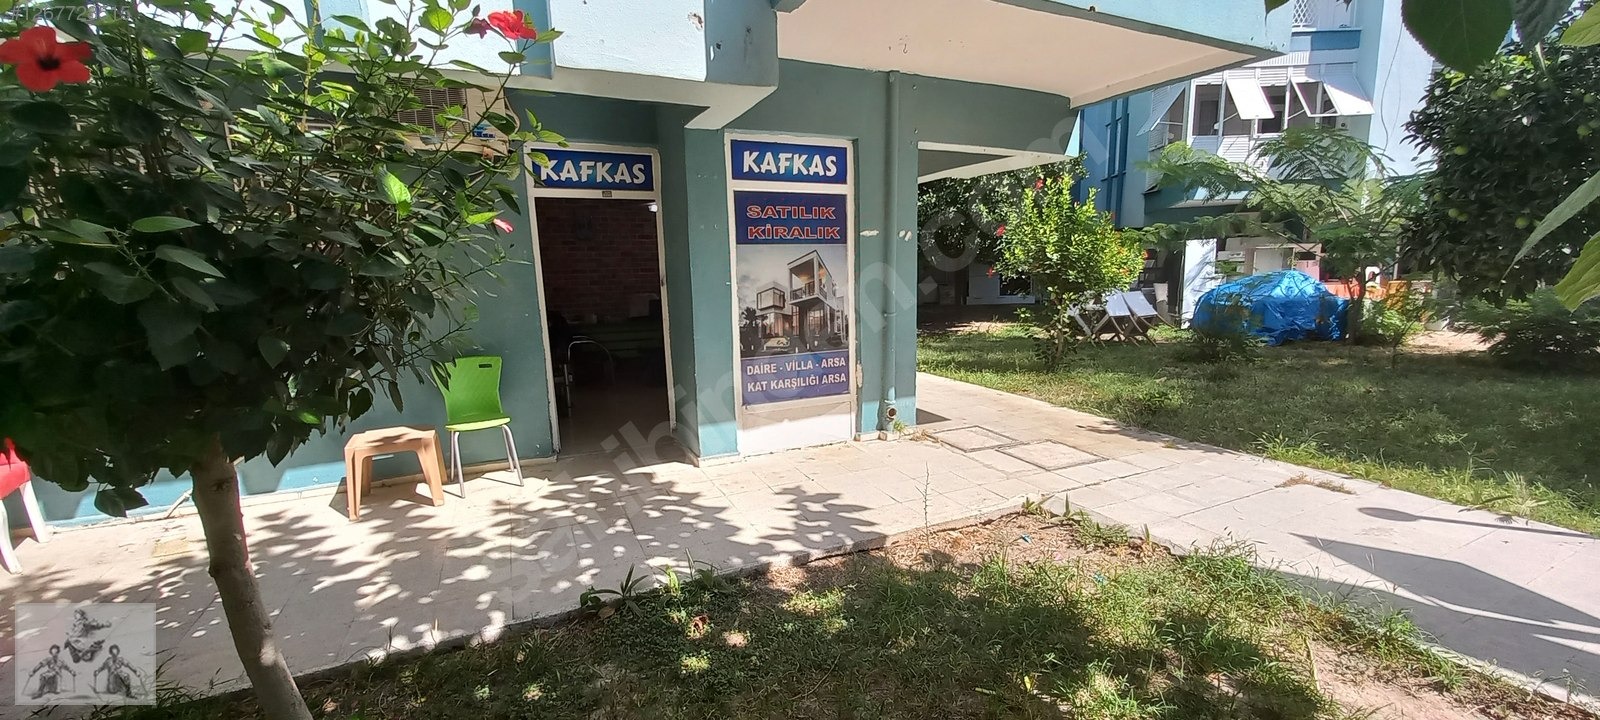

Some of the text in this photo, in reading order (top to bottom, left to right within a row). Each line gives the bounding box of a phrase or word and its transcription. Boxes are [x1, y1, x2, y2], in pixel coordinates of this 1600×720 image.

[540, 159, 646, 185] KAFKAS
[742, 150, 837, 178] KAFKAS
[746, 206, 837, 220] SATILIK
[747, 223, 841, 239] KİRALIK
[746, 362, 777, 376] DAİRE
[785, 359, 814, 372] VİLLA
[821, 357, 846, 369] ARSA
[747, 373, 847, 392] KAT KARŞILIĞI ARSA
